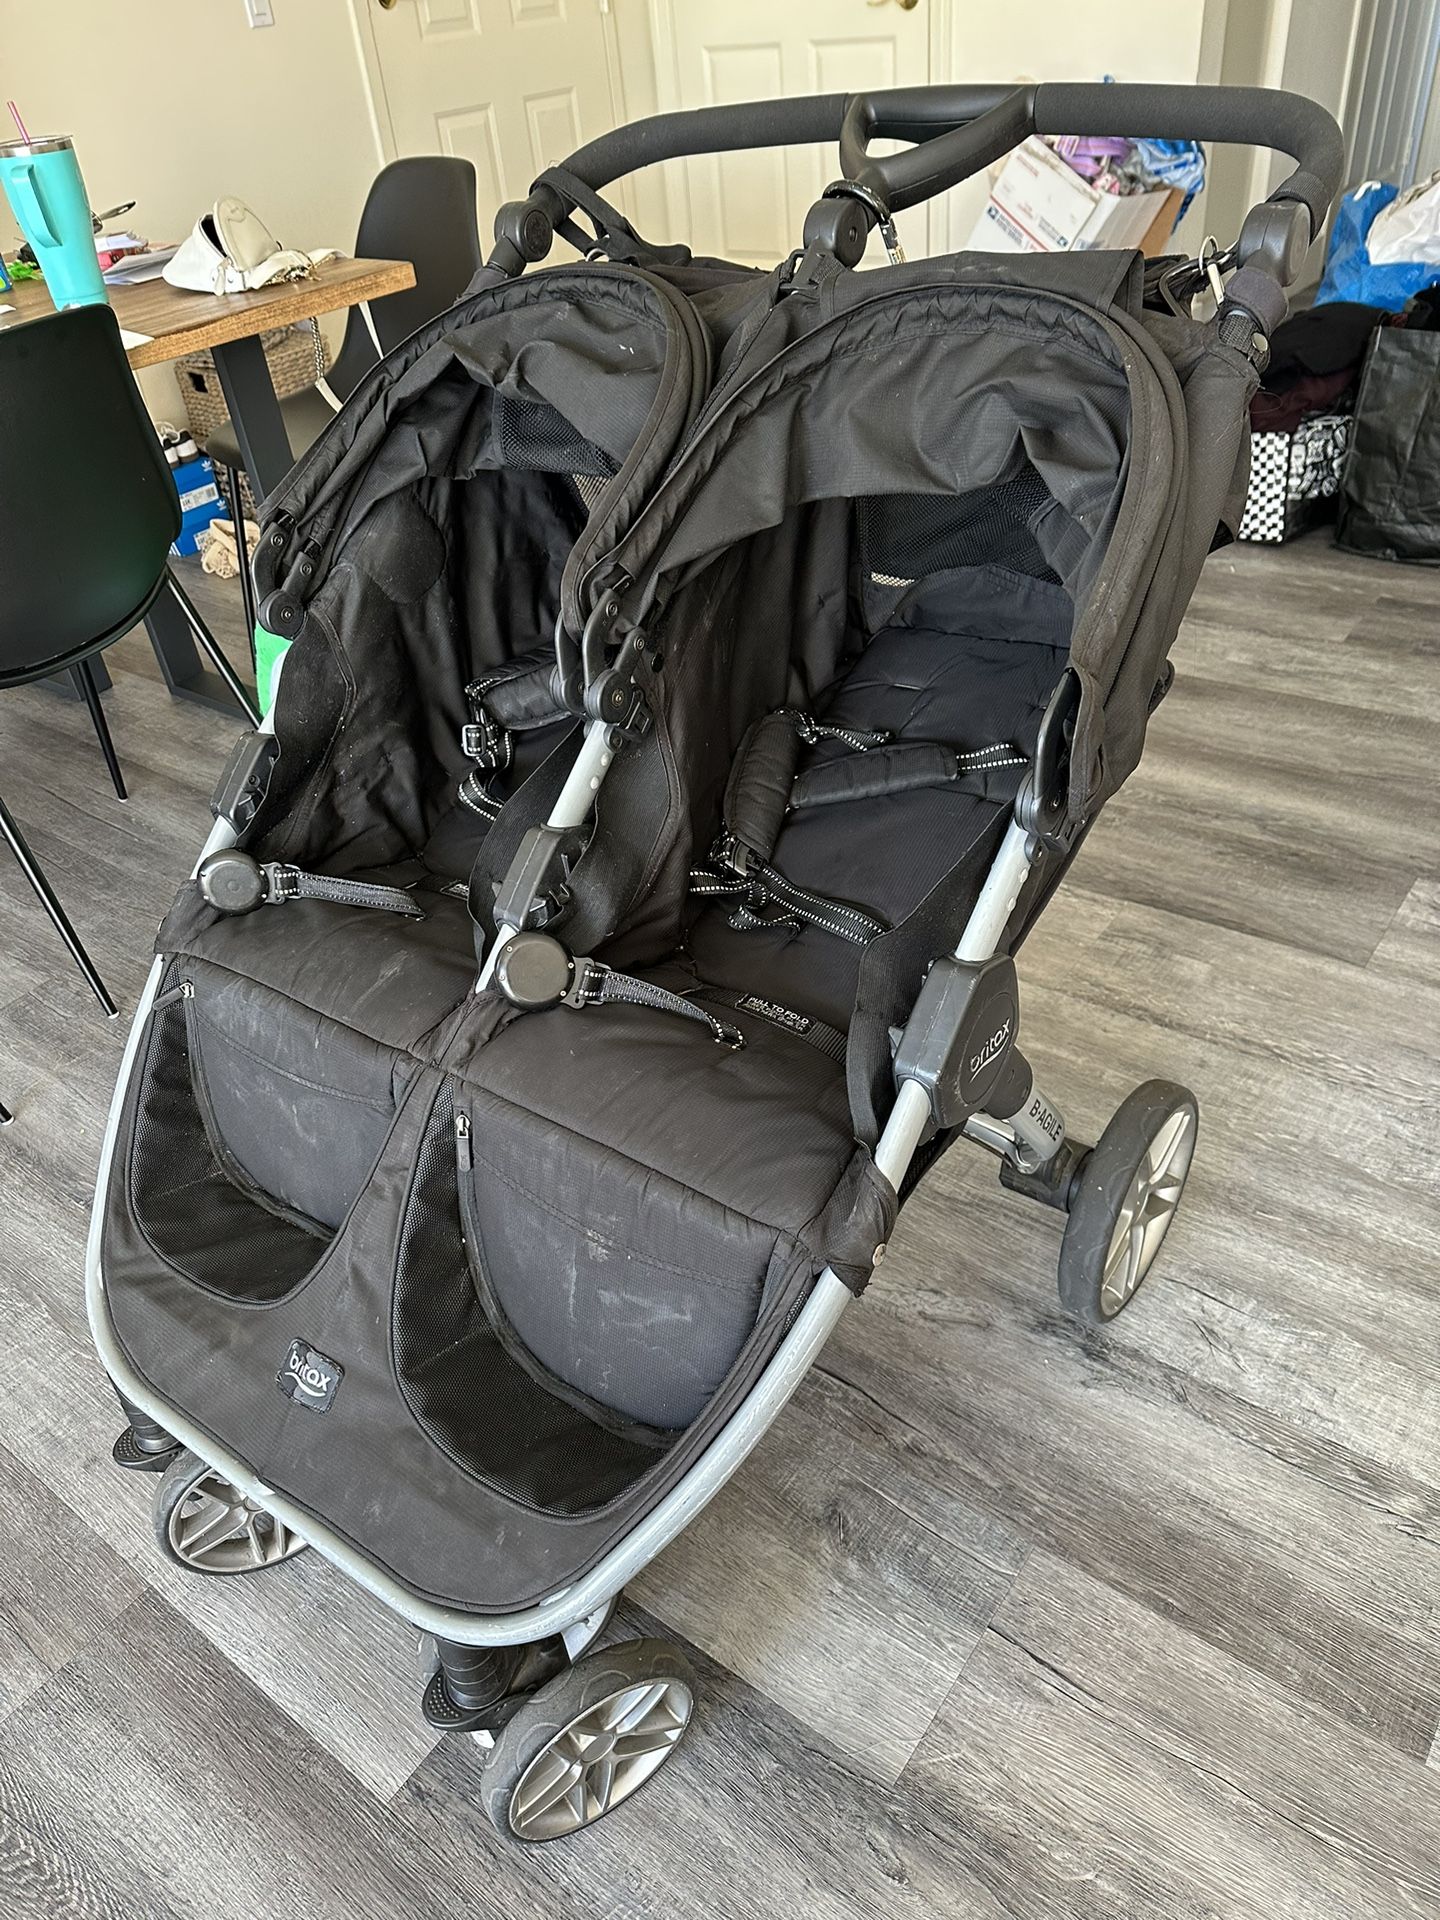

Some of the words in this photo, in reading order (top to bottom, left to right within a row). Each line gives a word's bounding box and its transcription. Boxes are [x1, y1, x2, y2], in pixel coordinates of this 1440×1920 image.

[748, 997, 769, 1007] PULL
[772, 1004, 785, 1013] TO
[785, 1010, 809, 1024] FOLD
[289, 1350, 331, 1392] britax
